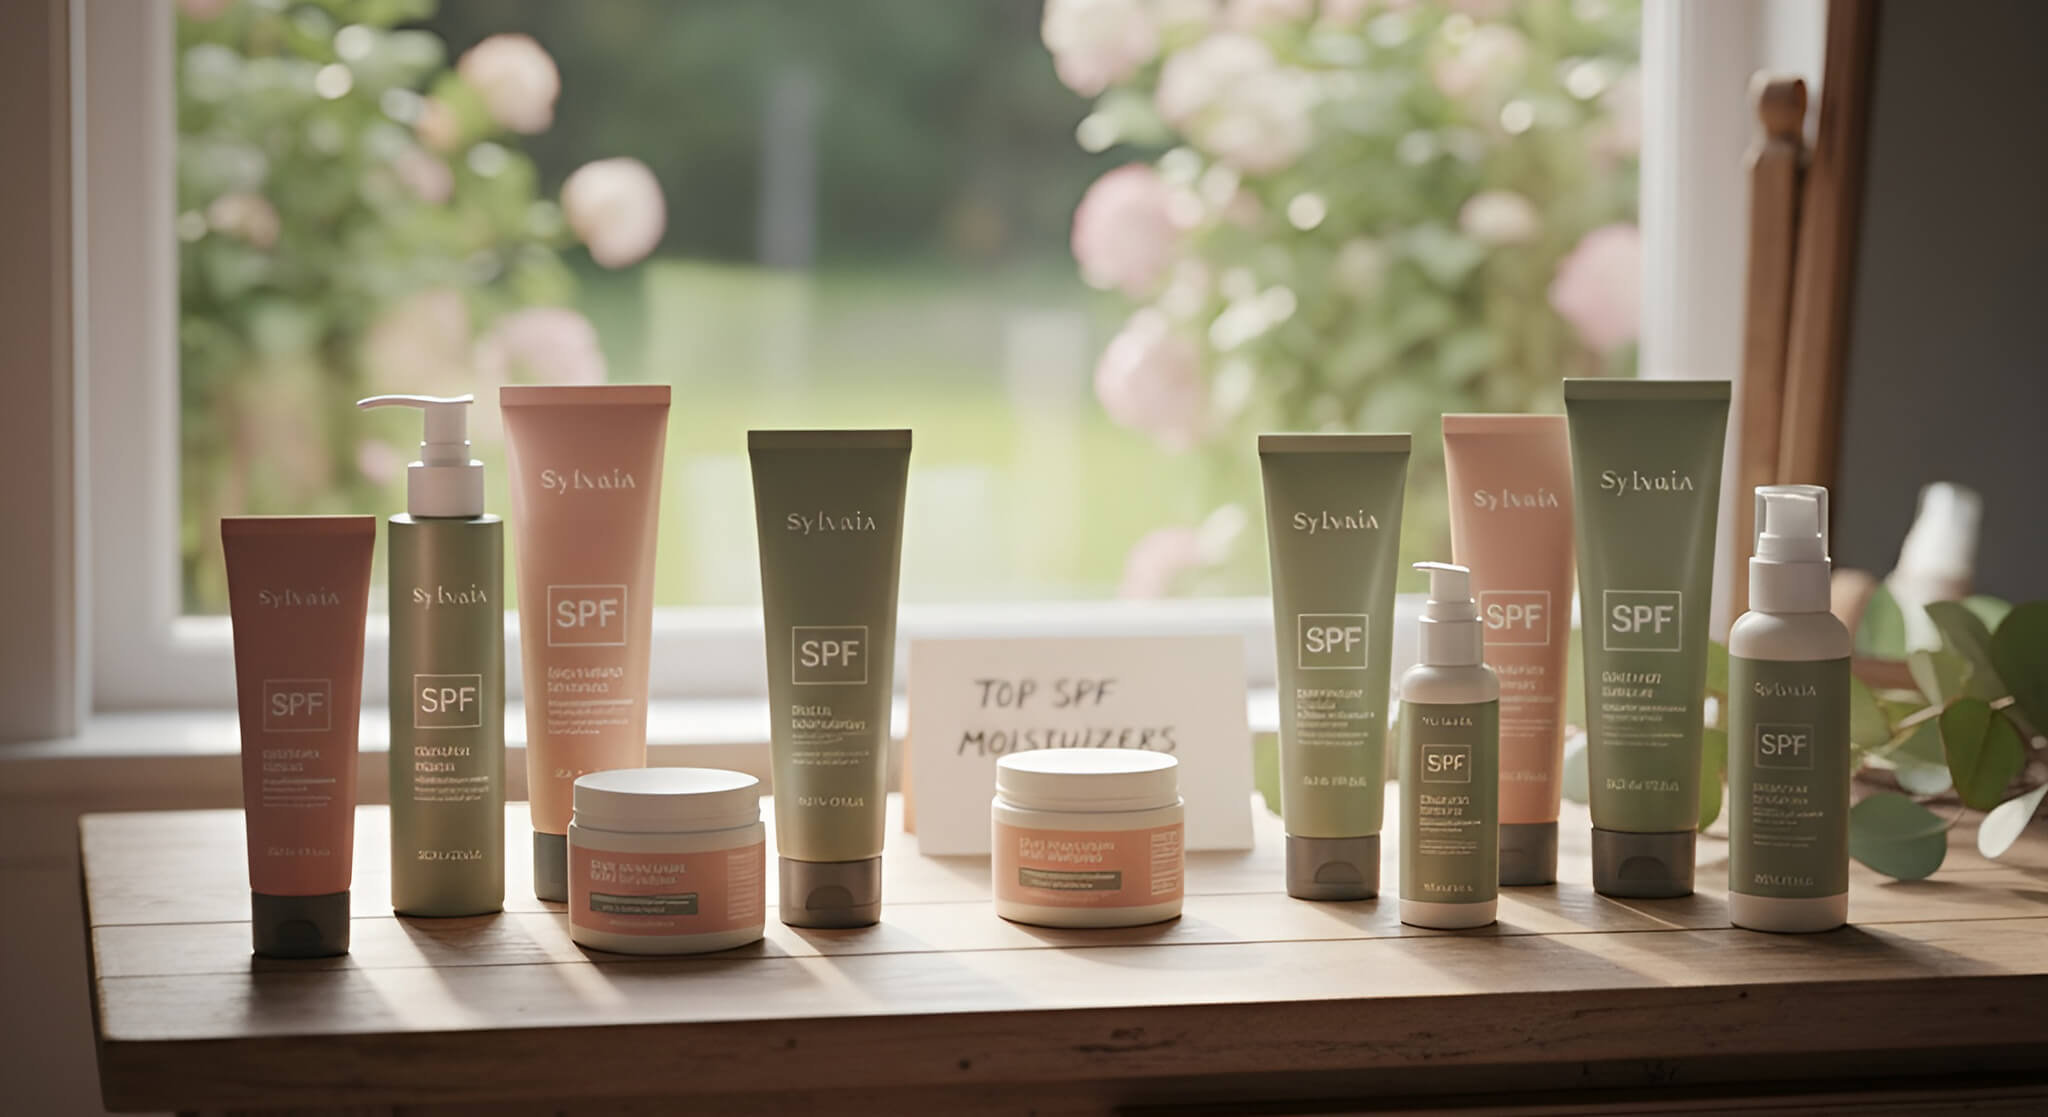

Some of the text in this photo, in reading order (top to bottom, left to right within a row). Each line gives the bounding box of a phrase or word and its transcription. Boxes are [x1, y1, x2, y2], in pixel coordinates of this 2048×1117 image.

[556, 599, 618, 628] SPF
[1486, 604, 1544, 631] SPF
[1611, 604, 1674, 634] SPF
[1305, 626, 1362, 653] SPF
[800, 640, 860, 667] SPF
[271, 692, 324, 717] SPF
[421, 687, 476, 713] SPF
[975, 677, 1117, 709] TOP SPF
[1760, 734, 1806, 756] SPF
[1427, 753, 1466, 773] SPF
